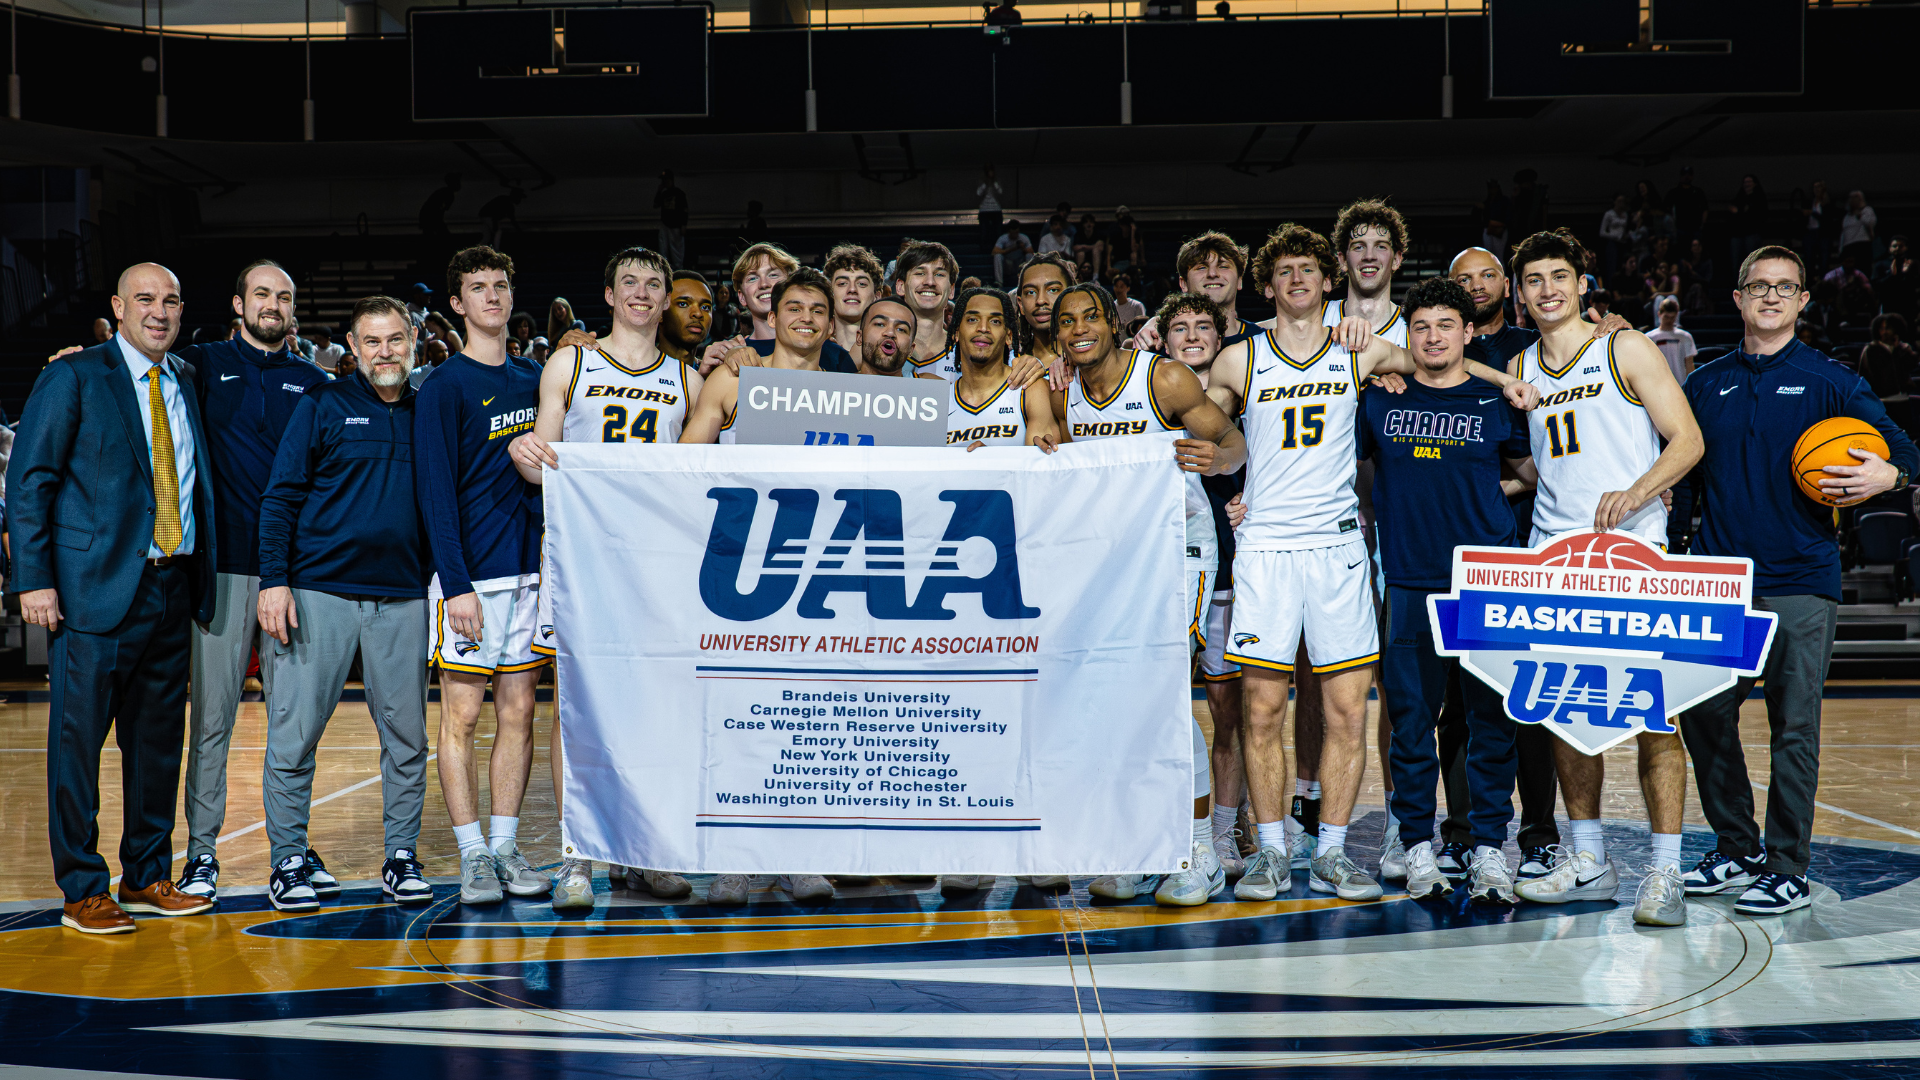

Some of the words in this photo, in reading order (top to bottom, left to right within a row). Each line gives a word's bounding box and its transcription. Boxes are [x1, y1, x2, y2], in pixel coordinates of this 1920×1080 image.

[1329, 364, 1346, 372] UAA
[1583, 365, 1601, 375] UAA
[658, 378, 676, 387] UAA
[585, 385, 678, 406] EMORY
[1257, 382, 1350, 403] EMORY
[1533, 382, 1605, 410] MORY
[748, 385, 938, 422] CHAMPIONS
[998, 406, 1015, 414] UAA
[1125, 402, 1143, 411] UAA
[488, 421, 535, 440] BASKETBA
[602, 404, 659, 443] 24
[1073, 420, 1148, 436] EMORY
[1281, 403, 1326, 450] 15
[1545, 409, 1581, 459] 11
[1413, 446, 1442, 459] UAA
[699, 487, 1041, 621] UAA
[1466, 568, 1554, 589] UNIVERSITY
[1561, 573, 1631, 593] ATHLETIC
[1639, 577, 1741, 599] ASSOCIATION
[1484, 603, 1723, 641] BASKETBALL
[699, 633, 811, 653] UNIVERSITY
[815, 634, 906, 653] ATHLETIC
[911, 636, 1039, 654] ASSOCIATION
[782, 690, 858, 703] Brandeis
[864, 692, 951, 706] University
[1507, 659, 1676, 733] UAA
[750, 704, 826, 719] Carnegie
[833, 705, 889, 718] Mellon
[895, 707, 981, 721] University
[723, 718, 765, 730] Case
[771, 719, 839, 732] Western
[846, 721, 915, 733] Reserve
[921, 722, 1007, 735] University
[792, 735, 846, 749] Emory
[853, 736, 939, 750] University
[780, 749, 815, 760] New
[821, 750, 858, 762] York
[864, 751, 950, 765] University
[773, 764, 860, 779] University
[865, 765, 883, 777] of
[888, 766, 958, 781] Chicago
[764, 778, 851, 793] University
[857, 780, 874, 791] of
[880, 781, 967, 792] Rochester
[716, 792, 817, 807] Washington
[824, 794, 910, 809] University
[917, 795, 932, 806] in
[938, 796, 961, 807] St.
[968, 796, 1015, 808] Louis
